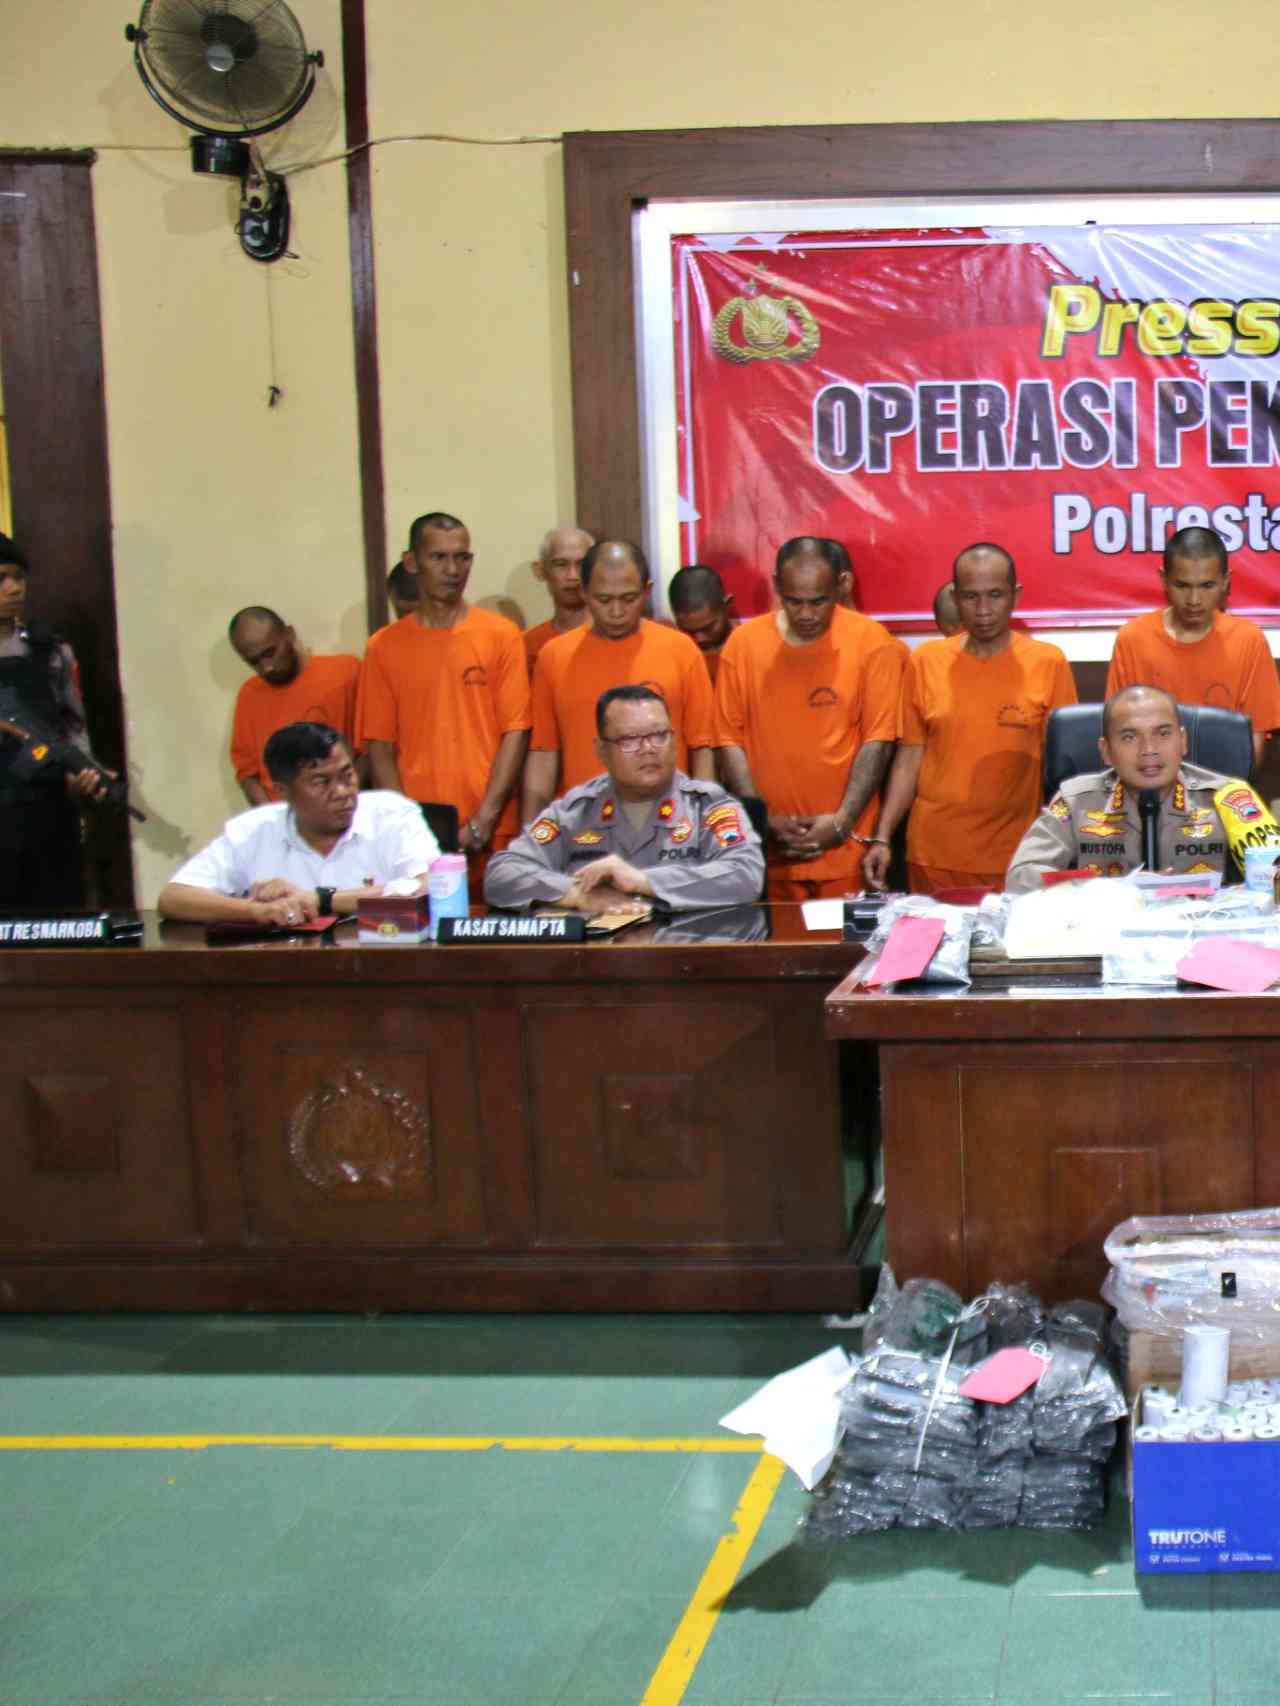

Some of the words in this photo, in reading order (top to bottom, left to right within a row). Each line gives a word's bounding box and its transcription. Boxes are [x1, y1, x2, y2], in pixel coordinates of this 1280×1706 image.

[813, 379, 1138, 473] OPERASI
[1079, 841, 1126, 856] MUSTOFA
[1175, 842, 1223, 857] POLRI
[453, 919, 498, 937] KASAT
[498, 918, 566, 937] SAMAPTA
[1148, 1529, 1227, 1545] TRUTONE
